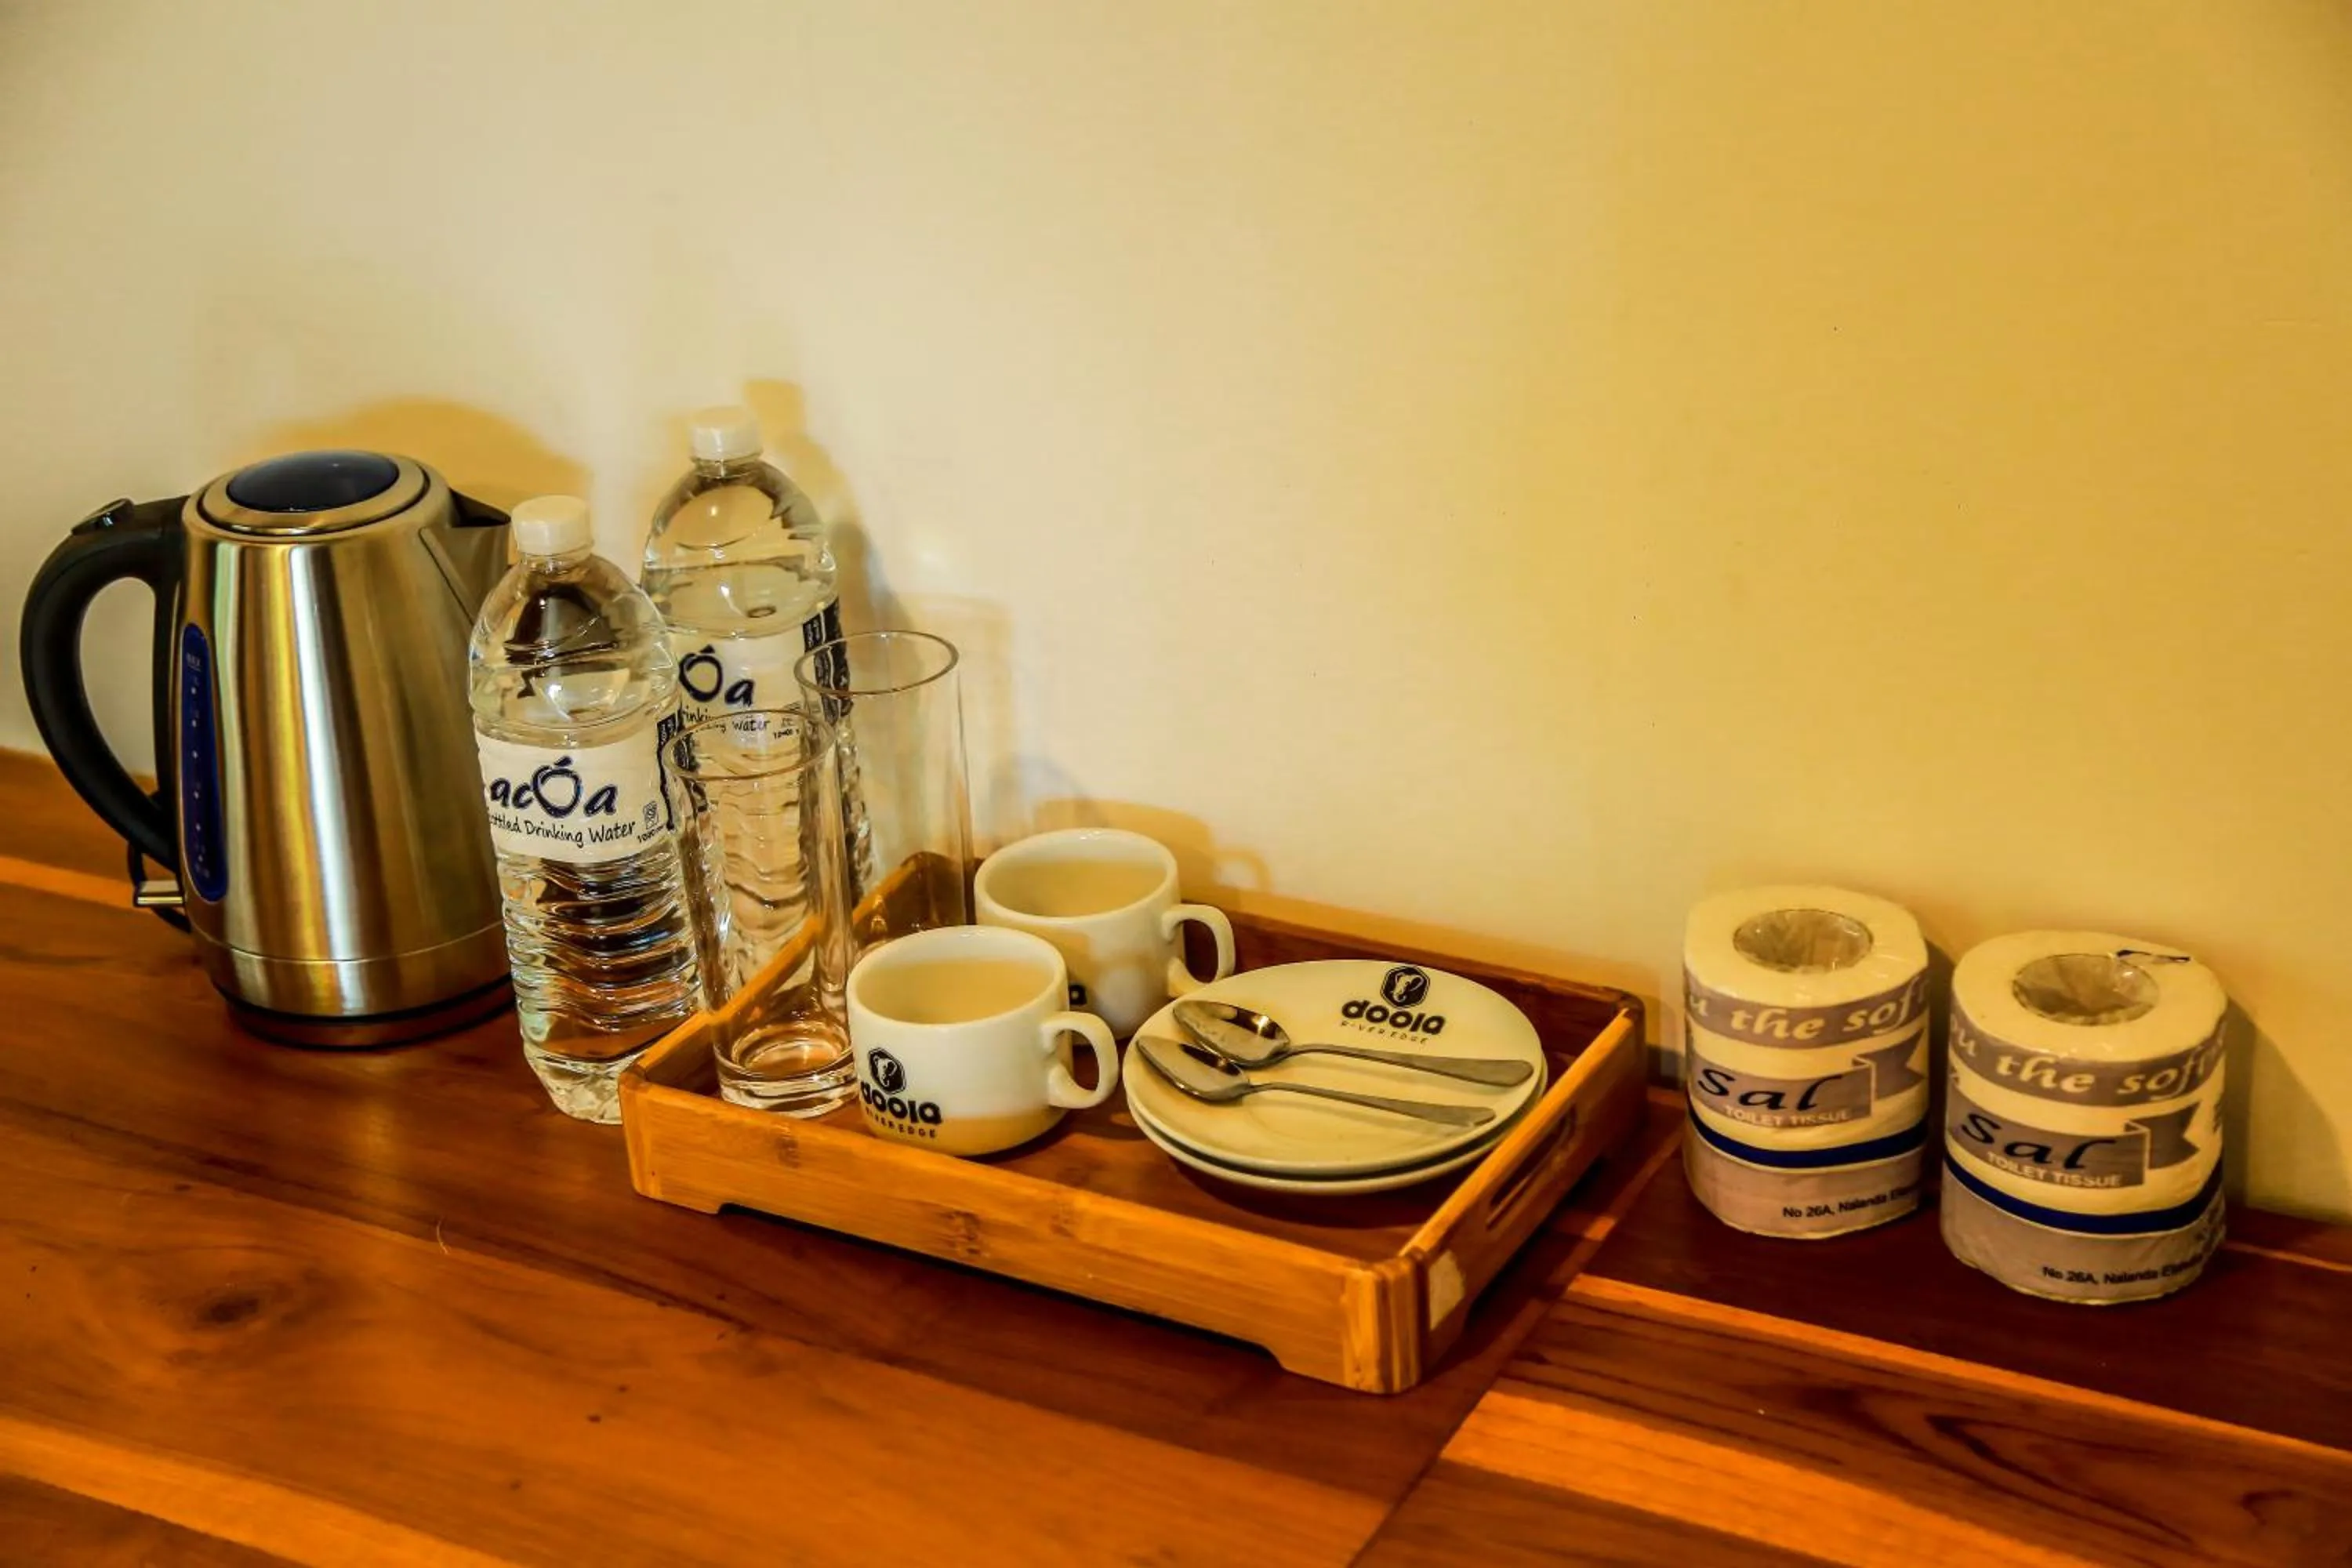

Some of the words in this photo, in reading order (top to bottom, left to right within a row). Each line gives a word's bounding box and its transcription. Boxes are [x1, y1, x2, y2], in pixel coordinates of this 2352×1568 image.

[524, 819, 584, 848] Drinking
[589, 822, 636, 844] Water
[1341, 1000, 1446, 1035] doola
[1730, 1008, 1825, 1040] the
[1697, 1068, 1845, 1112] Sal
[1998, 1056, 2096, 1093] the
[860, 1080, 943, 1126] doola
[1724, 1105, 1786, 1127] TOILET
[1790, 1107, 1851, 1126] TISSUE
[1960, 1112, 2117, 1171] Sal
[1987, 1152, 2047, 1180] TOILET
[2049, 1171, 2121, 1188] TISSUE
[1782, 1206, 1802, 1218] No
[2042, 1266, 2063, 1279] No
